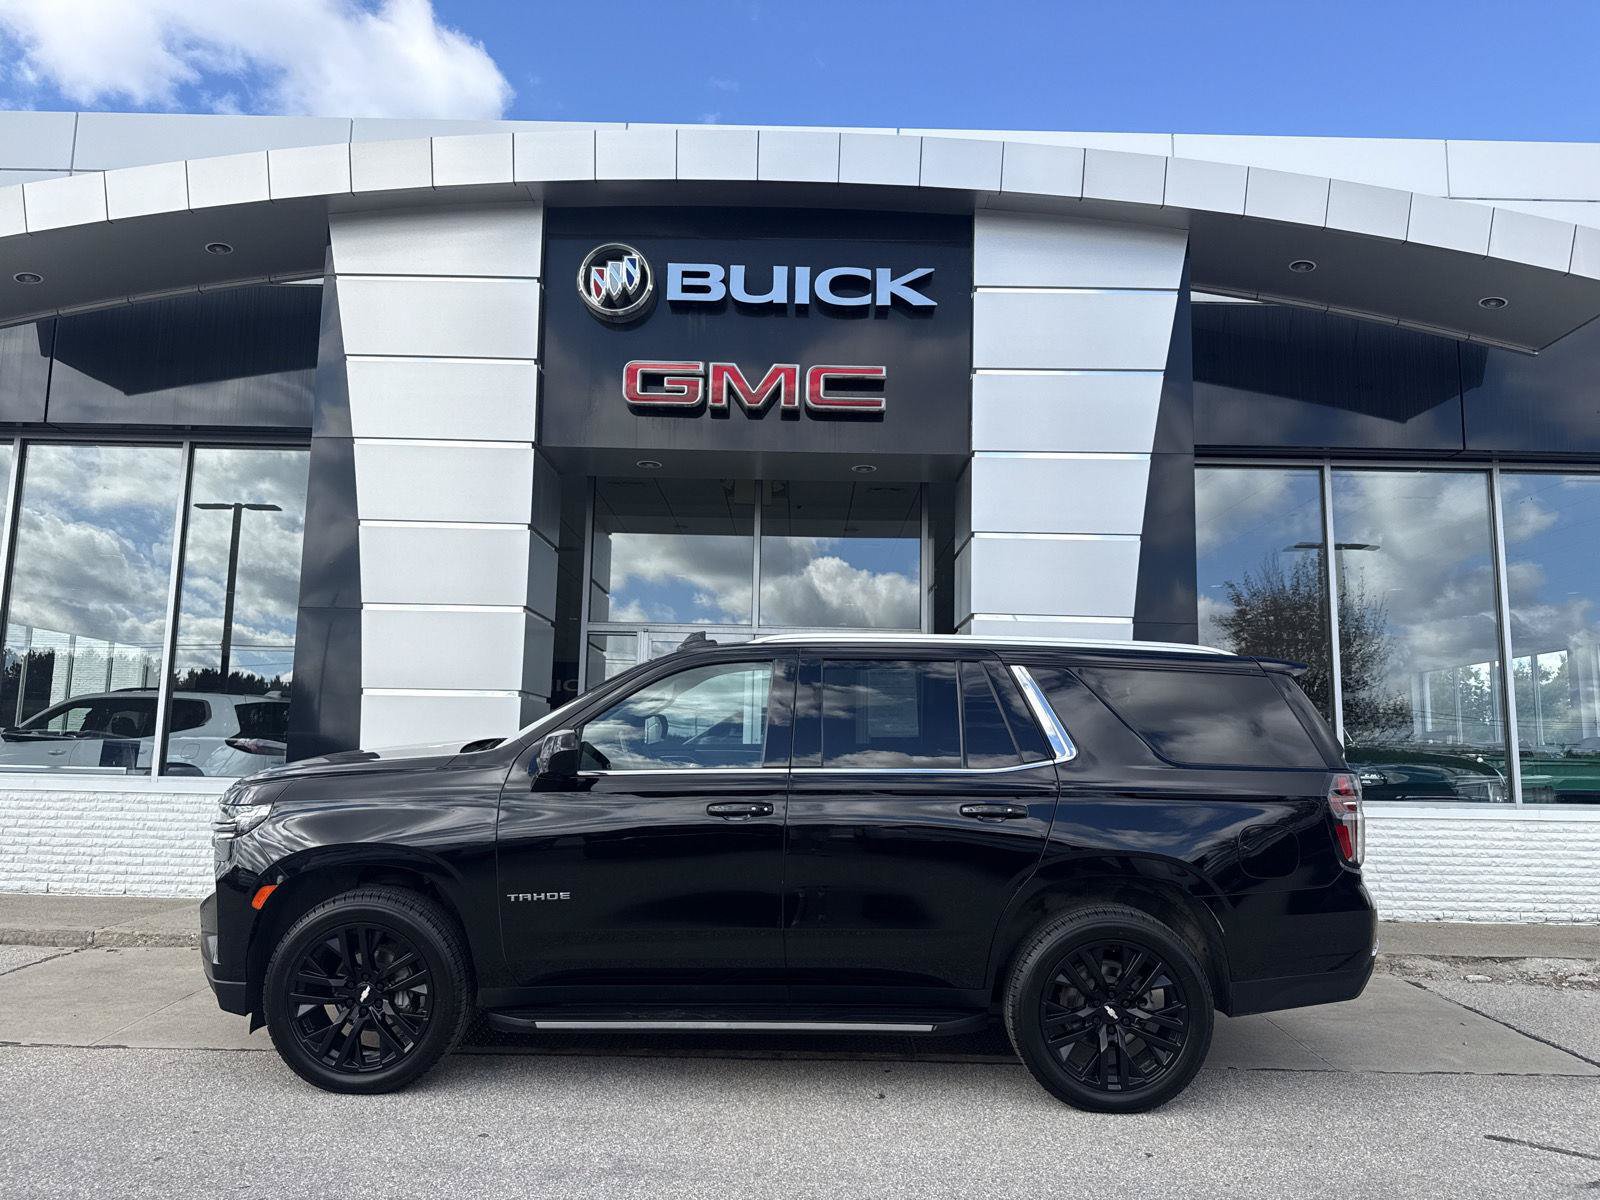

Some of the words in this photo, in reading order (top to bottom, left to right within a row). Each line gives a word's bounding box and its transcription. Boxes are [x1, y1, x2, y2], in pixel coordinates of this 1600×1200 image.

[667, 262, 938, 306] BUICK
[622, 360, 887, 411] GMC
[506, 891, 571, 902] TAHOE
